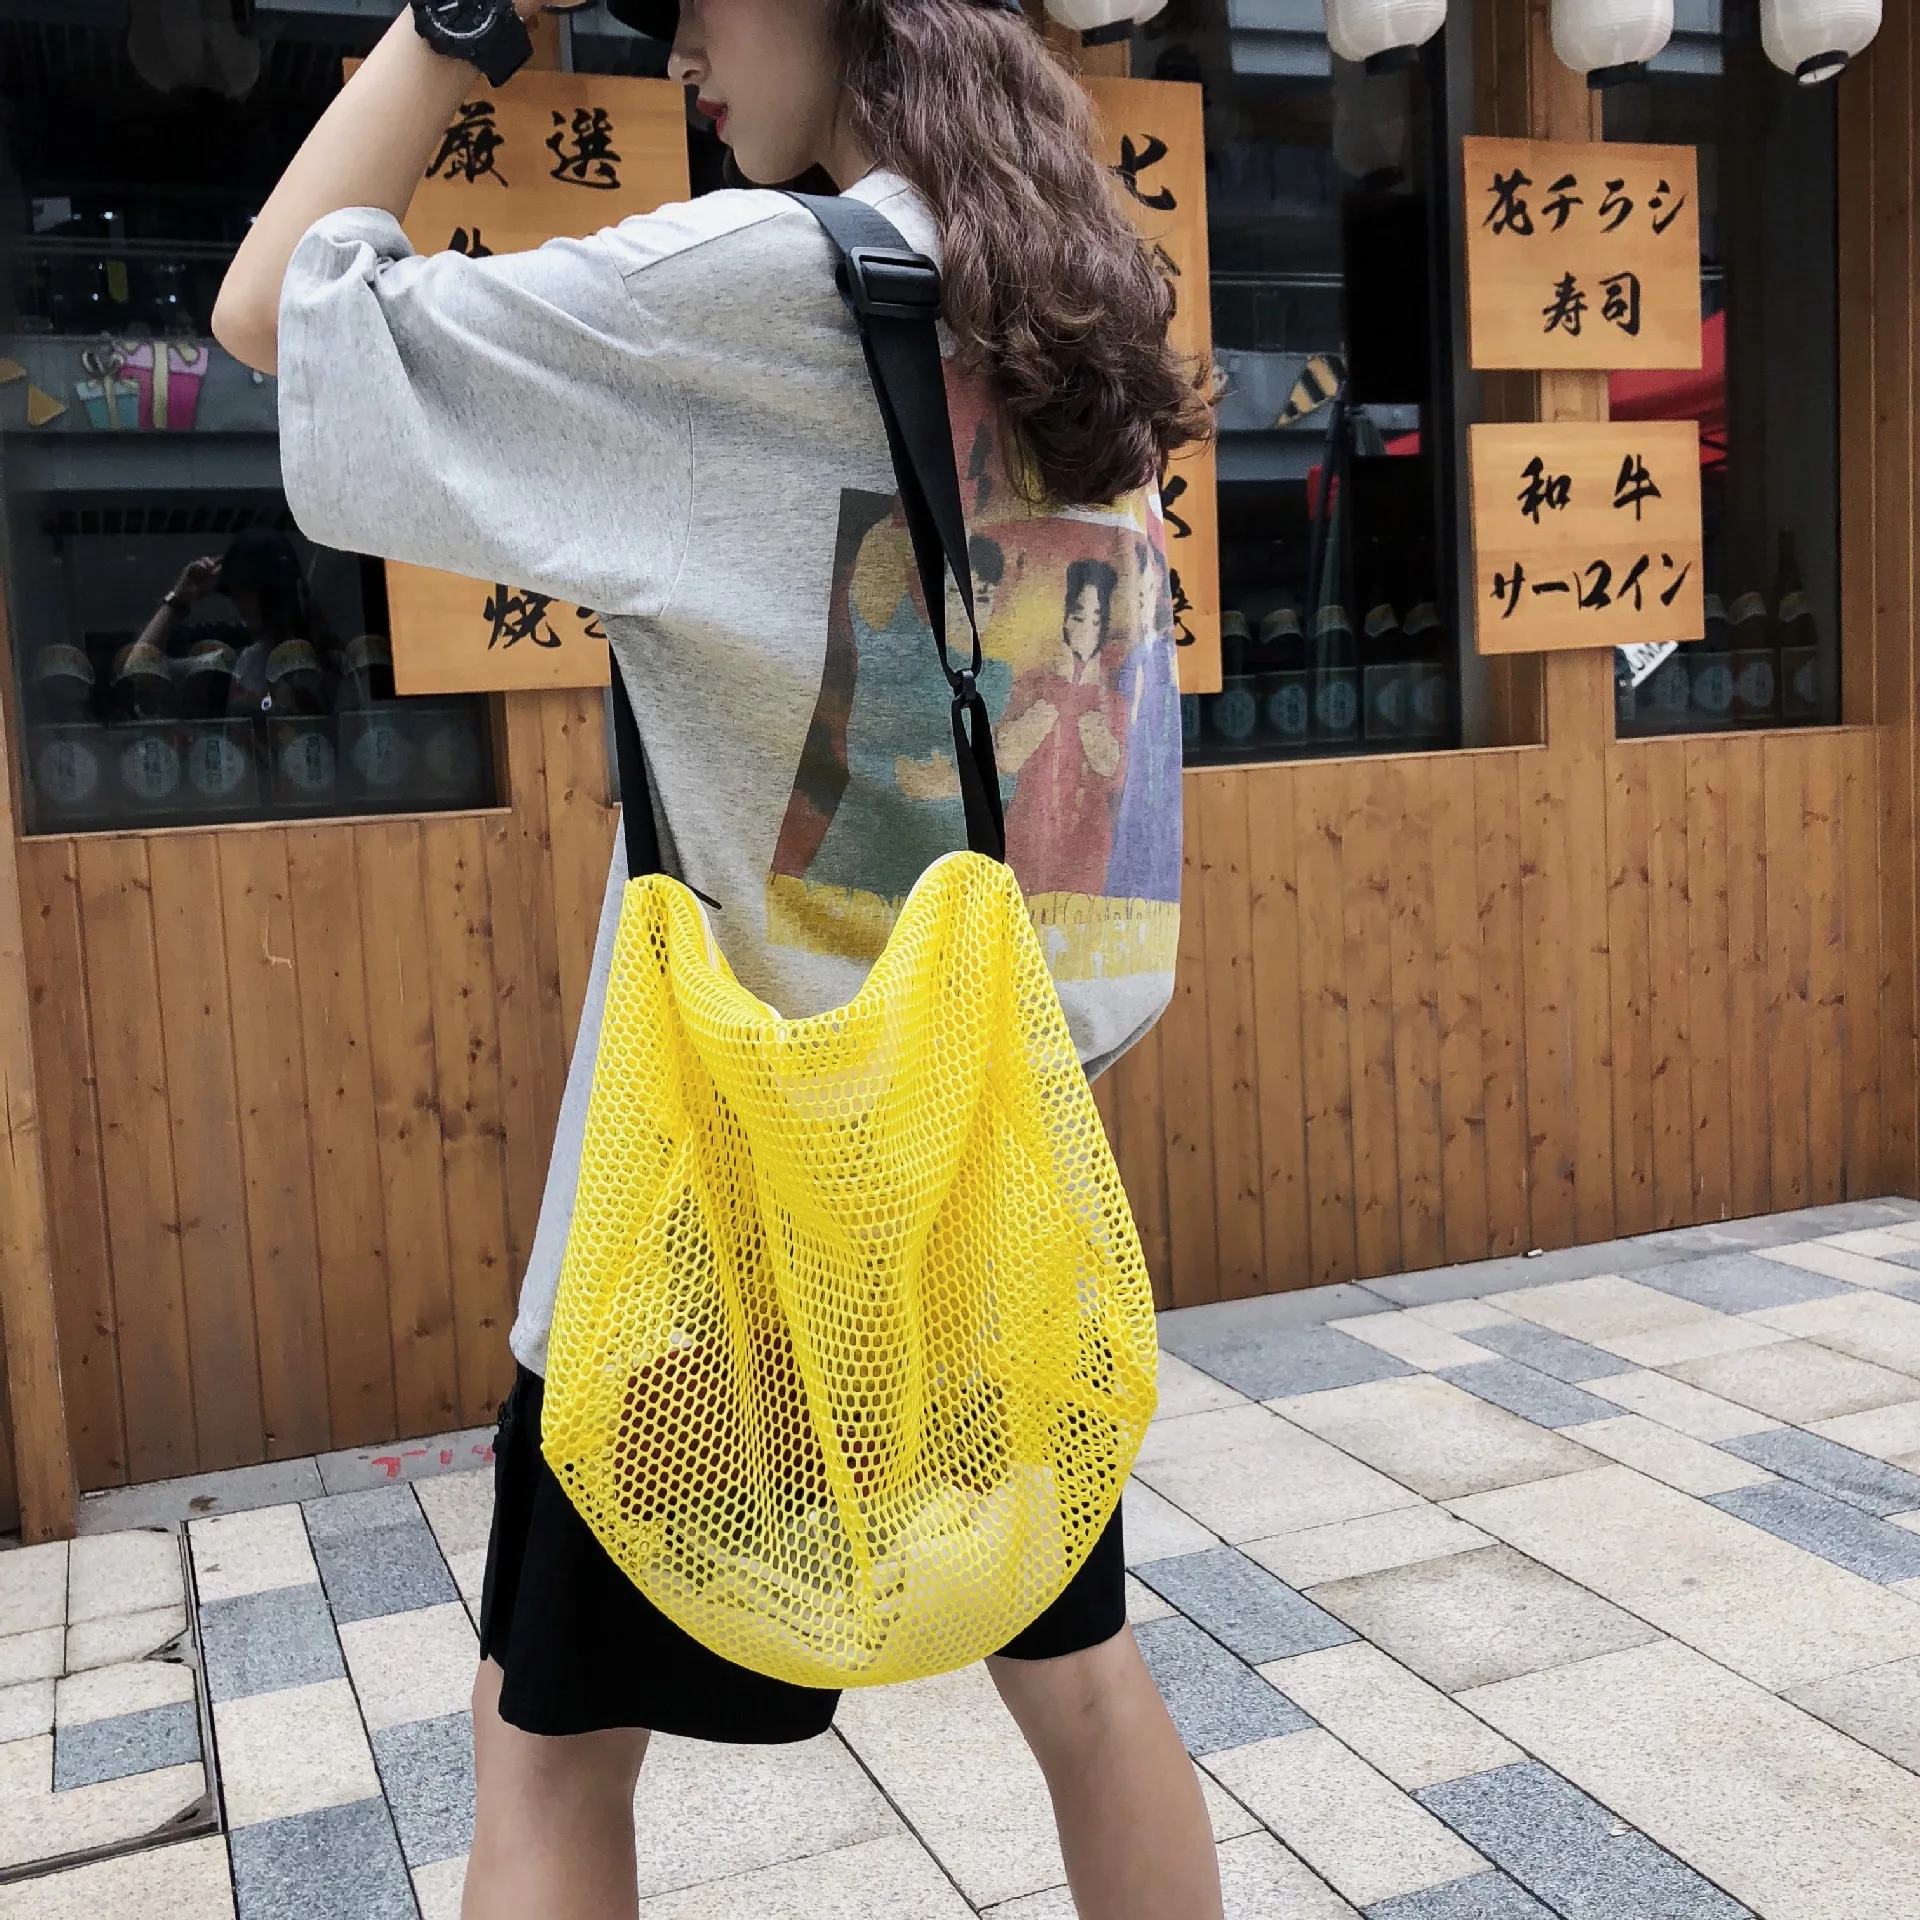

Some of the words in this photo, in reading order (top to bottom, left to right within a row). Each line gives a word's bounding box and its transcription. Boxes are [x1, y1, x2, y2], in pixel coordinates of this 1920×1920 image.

[1483, 168, 1688, 236] 花チラシ
[1542, 271, 1641, 336] 寿司
[1517, 454, 1662, 524] 和牛
[1490, 552, 1692, 620] サーロイン
